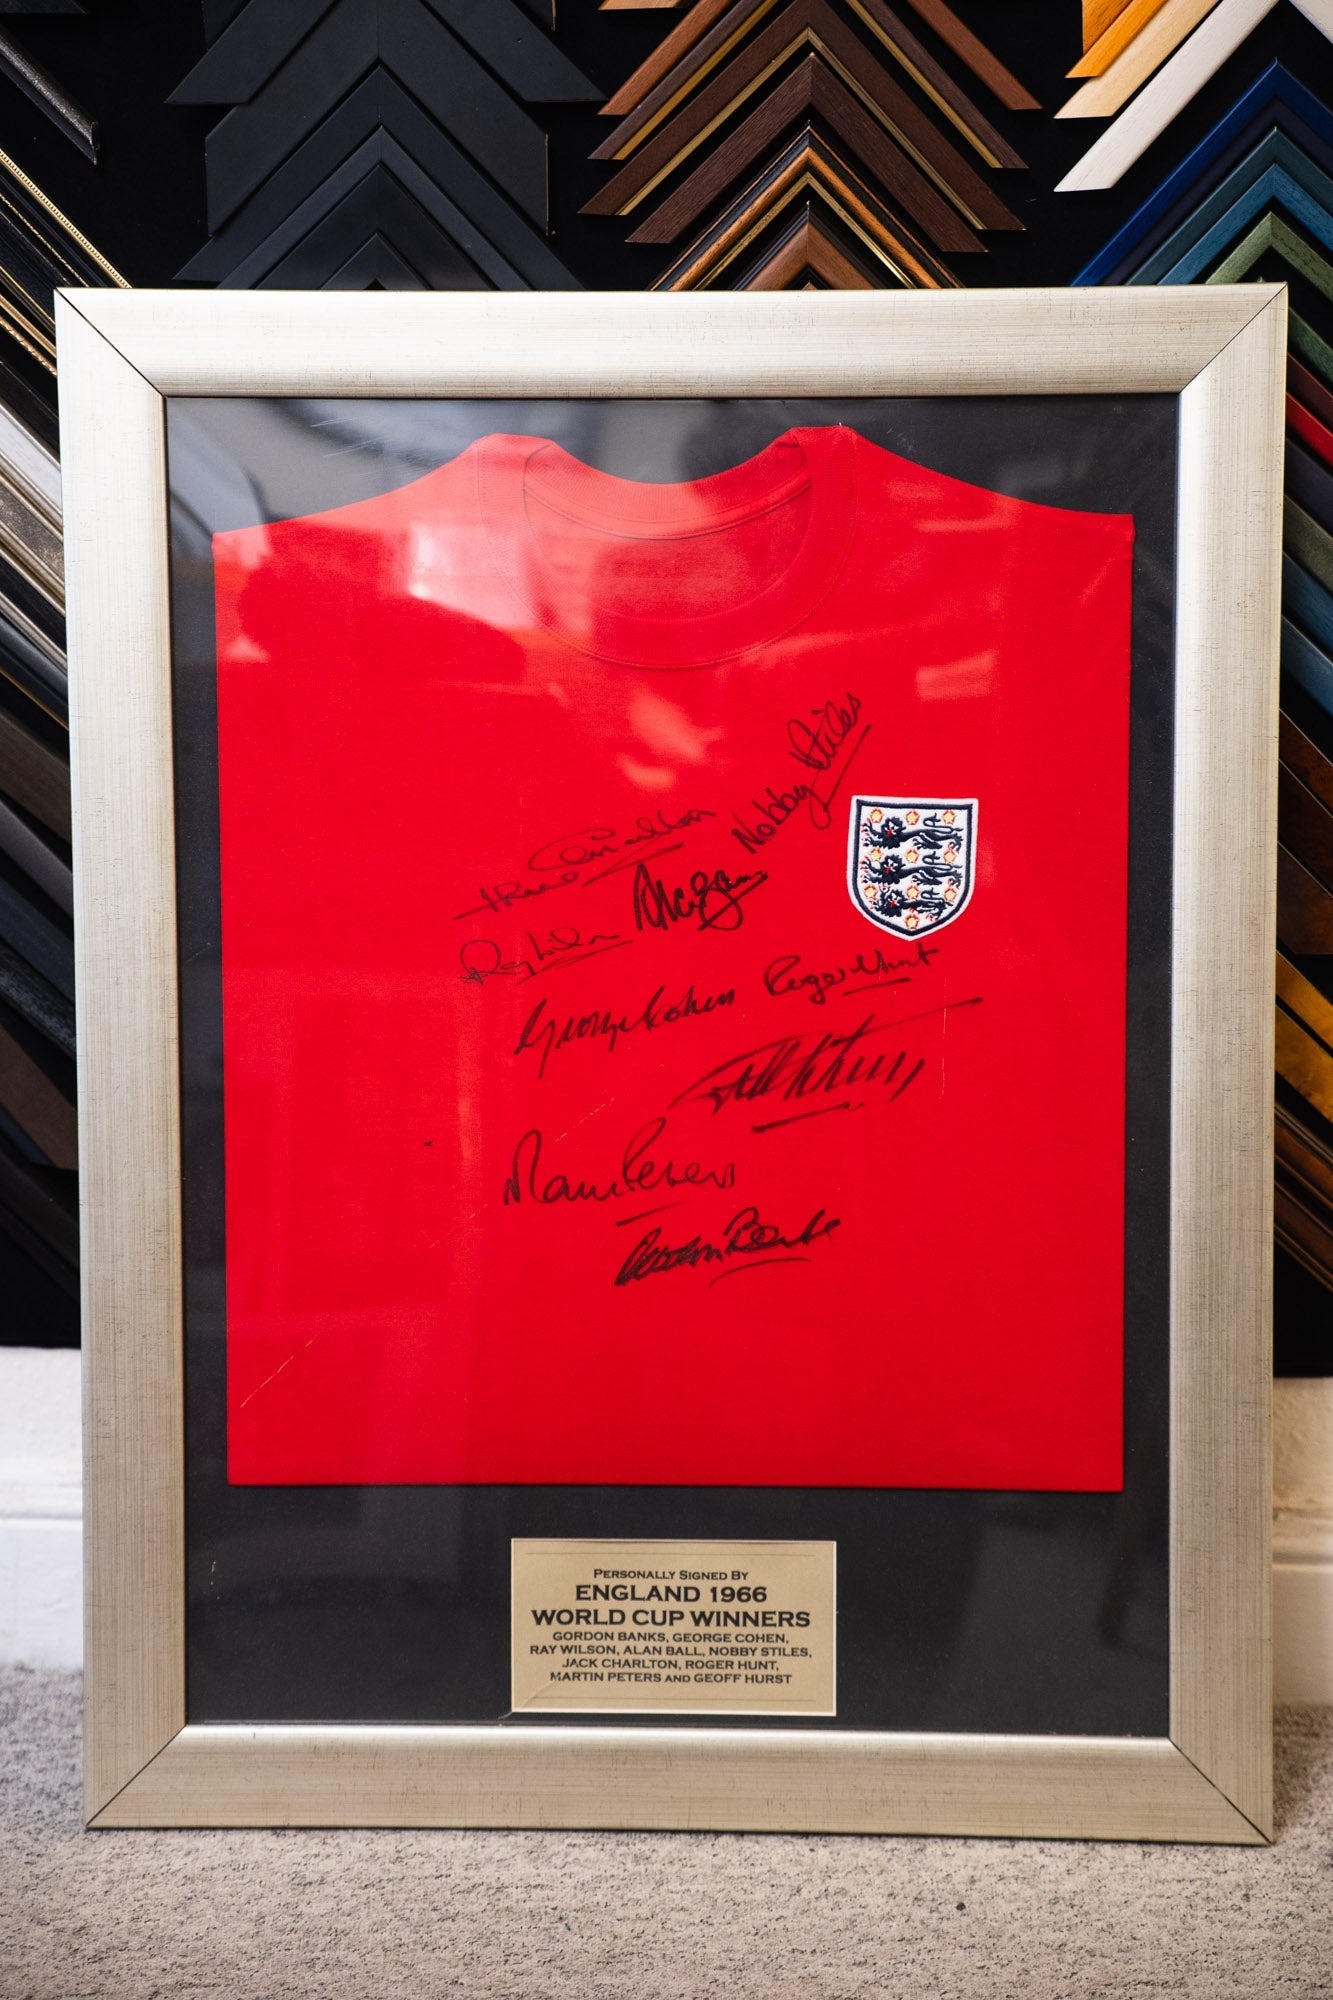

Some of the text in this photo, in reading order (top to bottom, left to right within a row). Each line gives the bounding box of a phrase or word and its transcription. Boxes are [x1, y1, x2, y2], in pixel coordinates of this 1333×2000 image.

[576, 1585, 767, 1602] ENGLAND 1966
[531, 1609, 810, 1627] WORLD CUP WINNERS
[553, 1632, 789, 1644] GORDON BANKS, GEORGE COHEN,
[530, 1645, 812, 1658] RAY WILSON, ALAN BALL, NOBBY STILES,
[562, 1659, 778, 1672] JACK CHARLTON, ROGER HUNT,
[550, 1672, 604, 1681] MARTIN
[607, 1672, 661, 1682] PETERS
[694, 1674, 741, 1683] GEOFF
[745, 1674, 792, 1684] HURST
